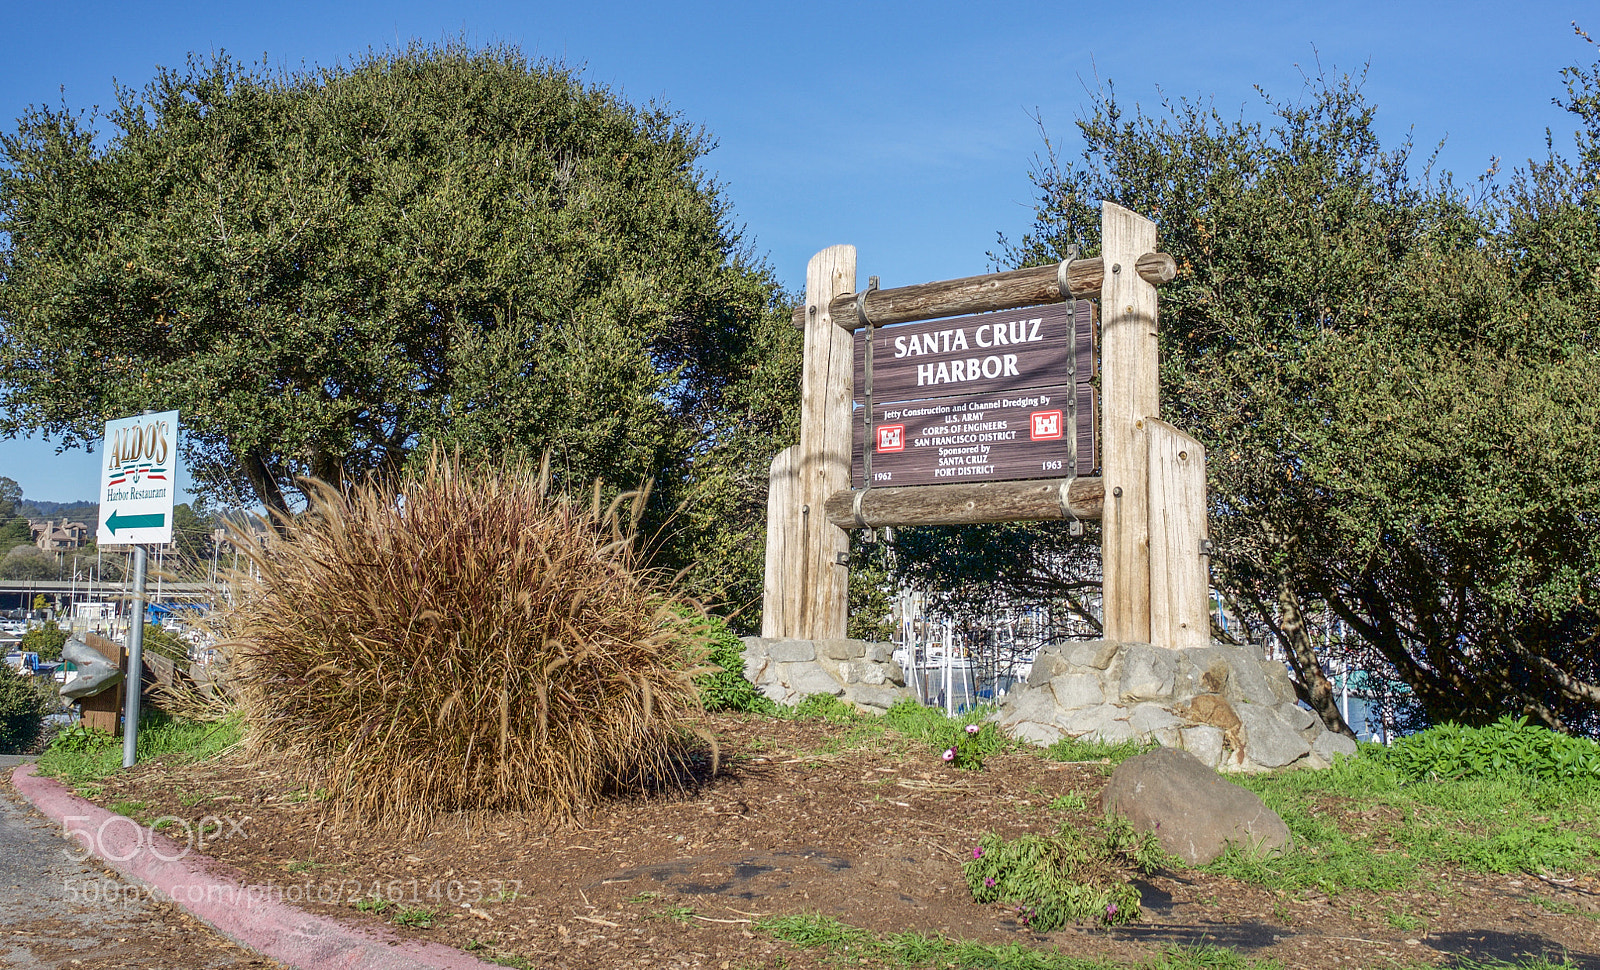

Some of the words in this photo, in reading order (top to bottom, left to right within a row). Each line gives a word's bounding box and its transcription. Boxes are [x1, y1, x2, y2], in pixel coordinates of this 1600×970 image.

[895, 329, 969, 358] SANTA
[976, 318, 1043, 348] CRUZ
[917, 354, 1020, 386] HARBOR
[884, 410, 901, 420] Jetty
[902, 405, 950, 417] Construction
[952, 403, 966, 412] and
[968, 400, 1000, 411] Channel
[1002, 397, 1038, 408] Dredging
[1040, 395, 1050, 405] By
[945, 414, 960, 423] U.S.
[962, 412, 984, 421] ARMY
[922, 425, 949, 435] CORPS
[951, 424, 961, 434] OF
[963, 421, 1007, 432] ENGINEERS
[108, 420, 169, 470] ALDO'S
[914, 438, 930, 447] SAN
[932, 435, 977, 446] FRANCISCO
[979, 431, 1016, 442] DISTRICT
[938, 445, 978, 457] Sponsored
[981, 444, 990, 454] by
[938, 457, 964, 466] SANTA
[965, 455, 988, 464] CRUZ
[1042, 461, 1062, 470] 1963
[874, 472, 892, 481] 1962
[934, 467, 956, 477] PORT
[958, 465, 995, 475] DISTRICT
[107, 488, 129, 502] Harbor
[130, 487, 166, 500] Restaurant
